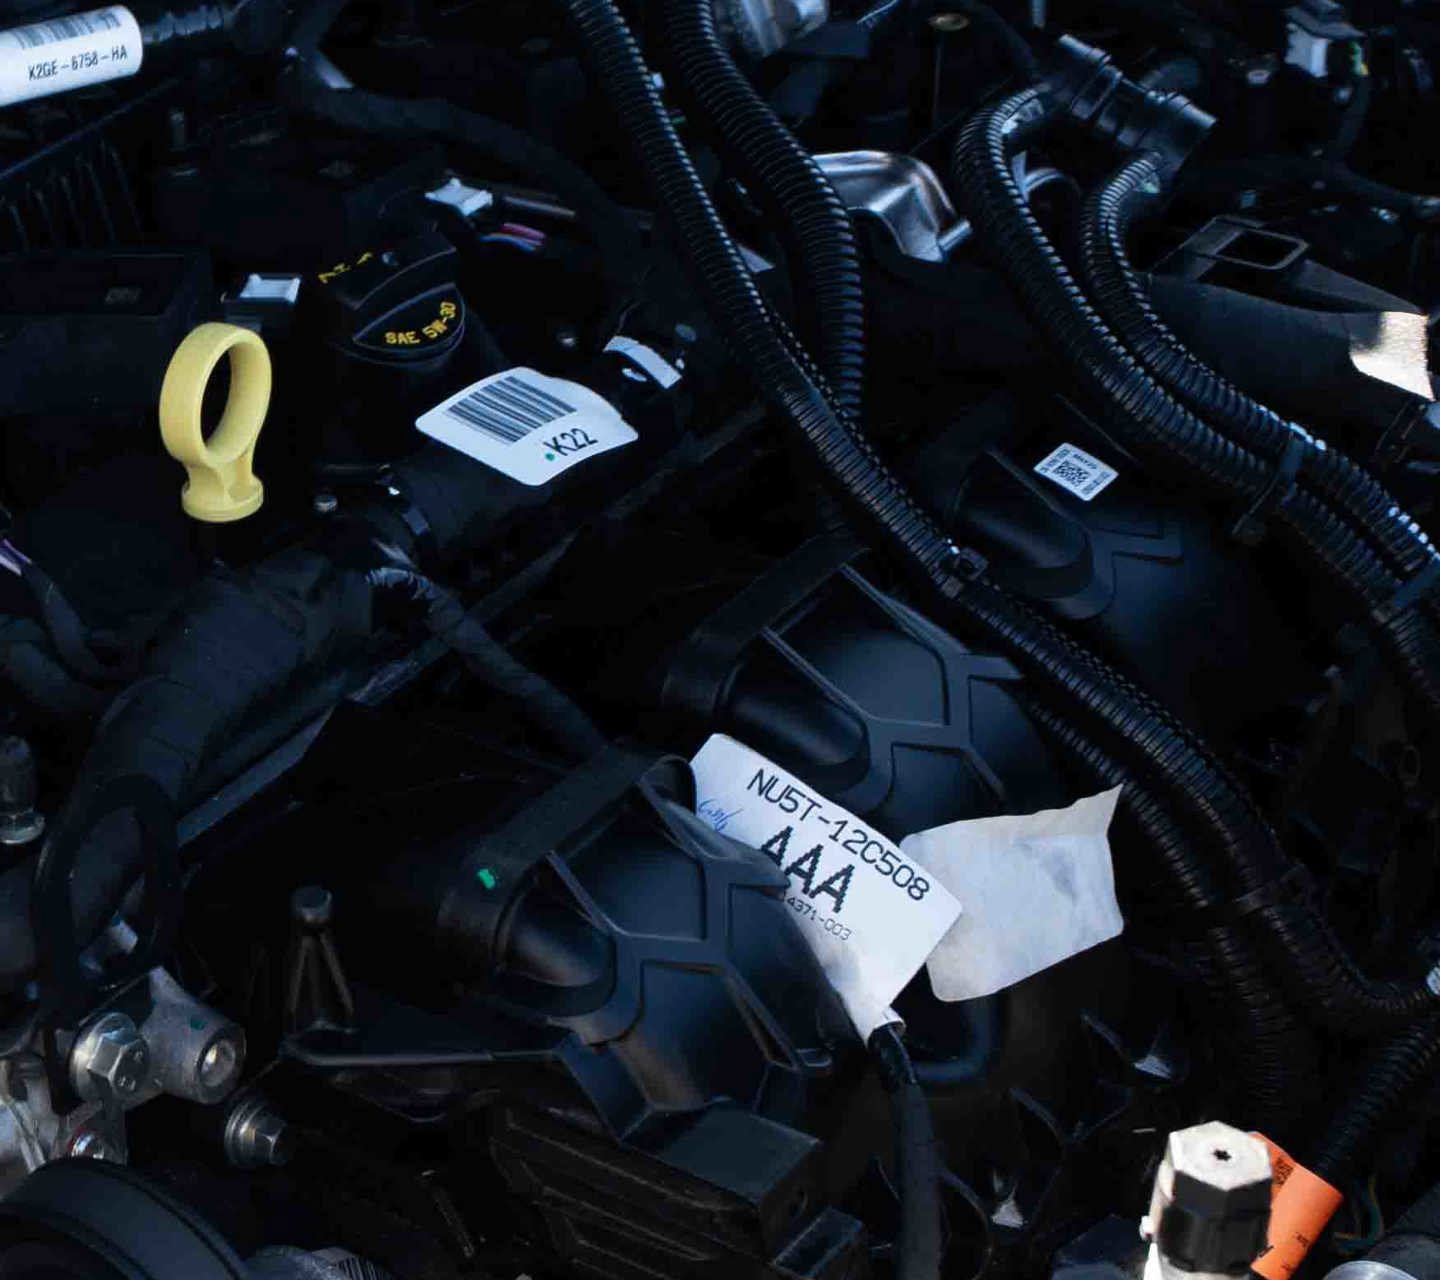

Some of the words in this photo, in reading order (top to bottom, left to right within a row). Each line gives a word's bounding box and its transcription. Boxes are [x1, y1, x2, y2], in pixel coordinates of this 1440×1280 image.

[384, 330, 421, 345] SAE
[543, 427, 599, 457] K22
[746, 768, 931, 902] NU5T-12C508
[760, 825, 856, 914] AAA
